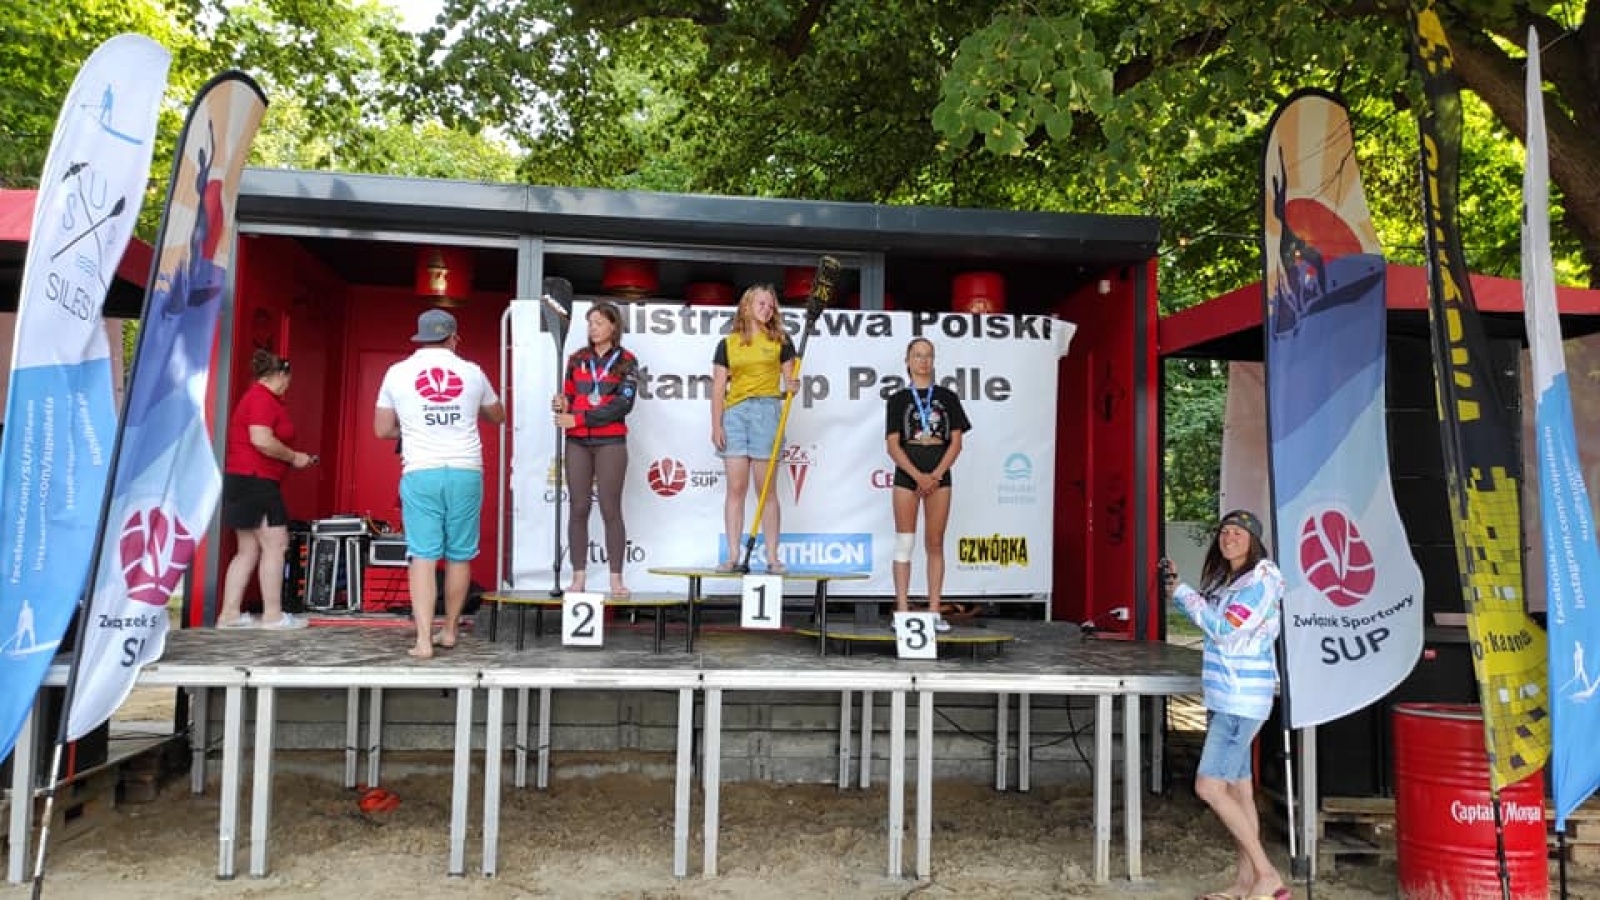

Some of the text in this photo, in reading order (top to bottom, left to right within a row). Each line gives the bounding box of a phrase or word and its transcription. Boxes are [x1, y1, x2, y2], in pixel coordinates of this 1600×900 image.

[848, 366, 1013, 401] Padle
[425, 413, 461, 426] SUP
[690, 476, 719, 488] SUP
[958, 534, 1028, 565] CZWÓRKA
[751, 584, 771, 620] 1
[1341, 594, 1414, 630] Sportowy
[570, 601, 596, 638] 2
[904, 617, 926, 650] 3
[1321, 627, 1390, 665] SUP
[1450, 800, 1497, 826] Captai
